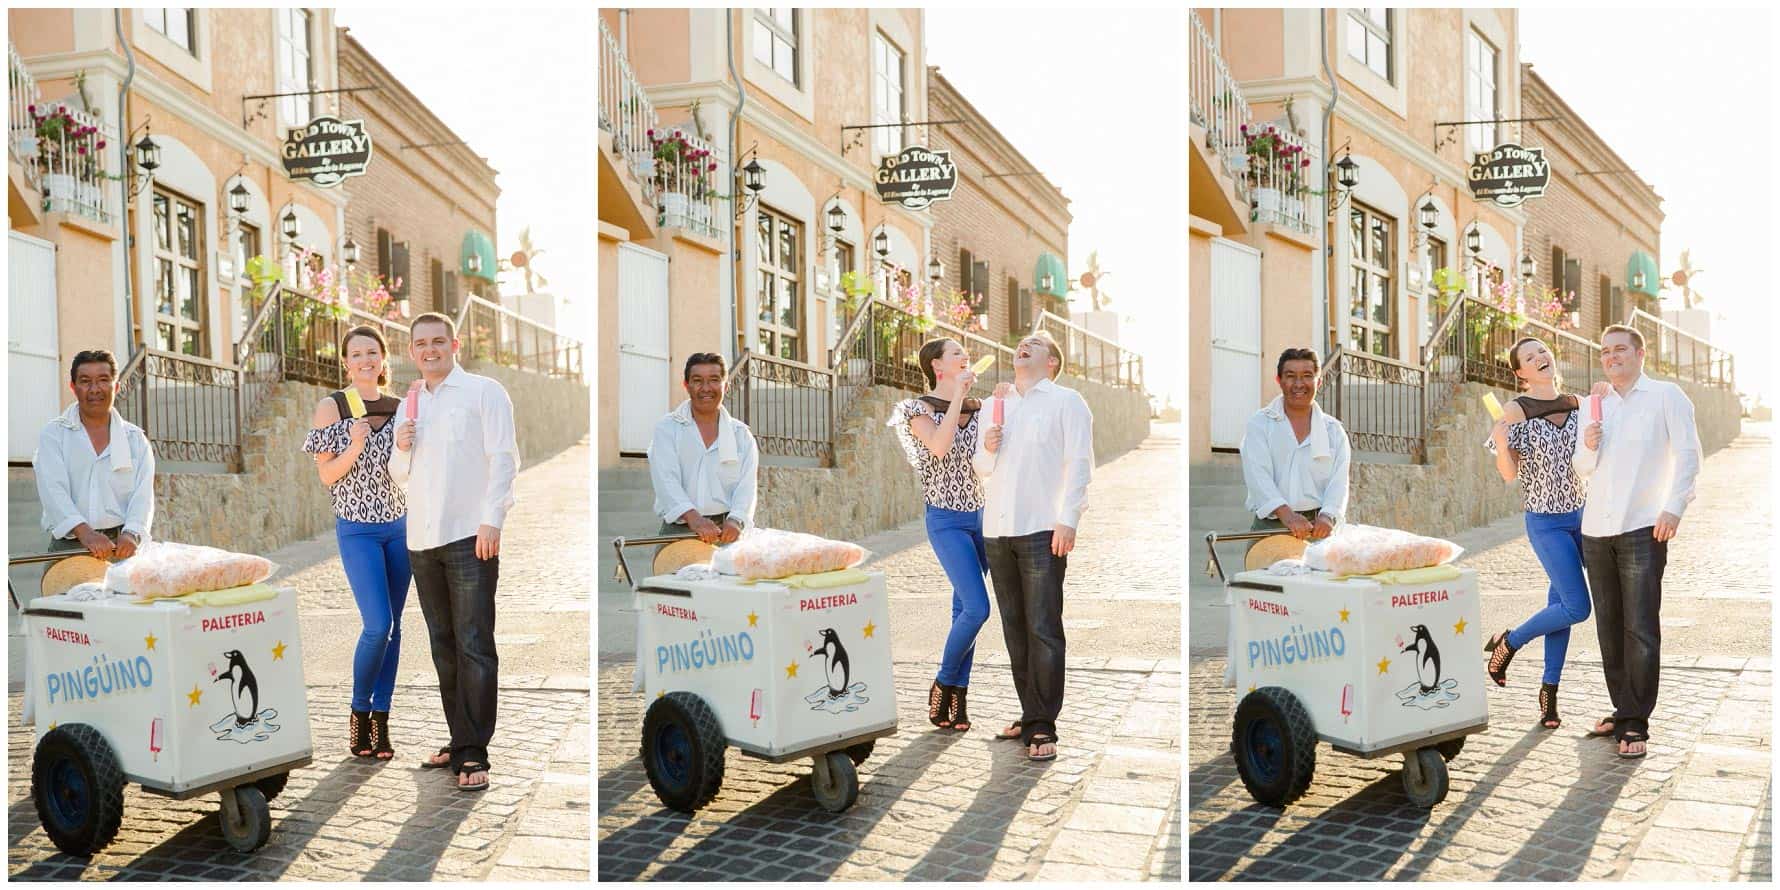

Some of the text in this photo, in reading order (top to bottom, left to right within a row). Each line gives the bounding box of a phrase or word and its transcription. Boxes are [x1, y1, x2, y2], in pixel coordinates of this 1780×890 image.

[293, 121, 357, 141] OLD TOWN
[282, 135, 367, 160] GALLERY
[1480, 147, 1537, 165] OLD TOWN
[886, 150, 944, 168] OLD TOWN
[875, 164, 953, 184] GALLERY
[1468, 161, 1546, 181] GALLERY
[800, 593, 857, 612] PALETERIA
[1249, 598, 1289, 616] PALETERIA
[1391, 590, 1449, 608] PALETERIA
[202, 610, 265, 633] PALETERIA
[657, 603, 698, 622] PALETERIA
[46, 627, 91, 647] PALETERIA
[1248, 624, 1346, 669] PINGÜINO
[656, 628, 754, 674] PINGÜINO
[47, 653, 153, 704] PINGÜINO
